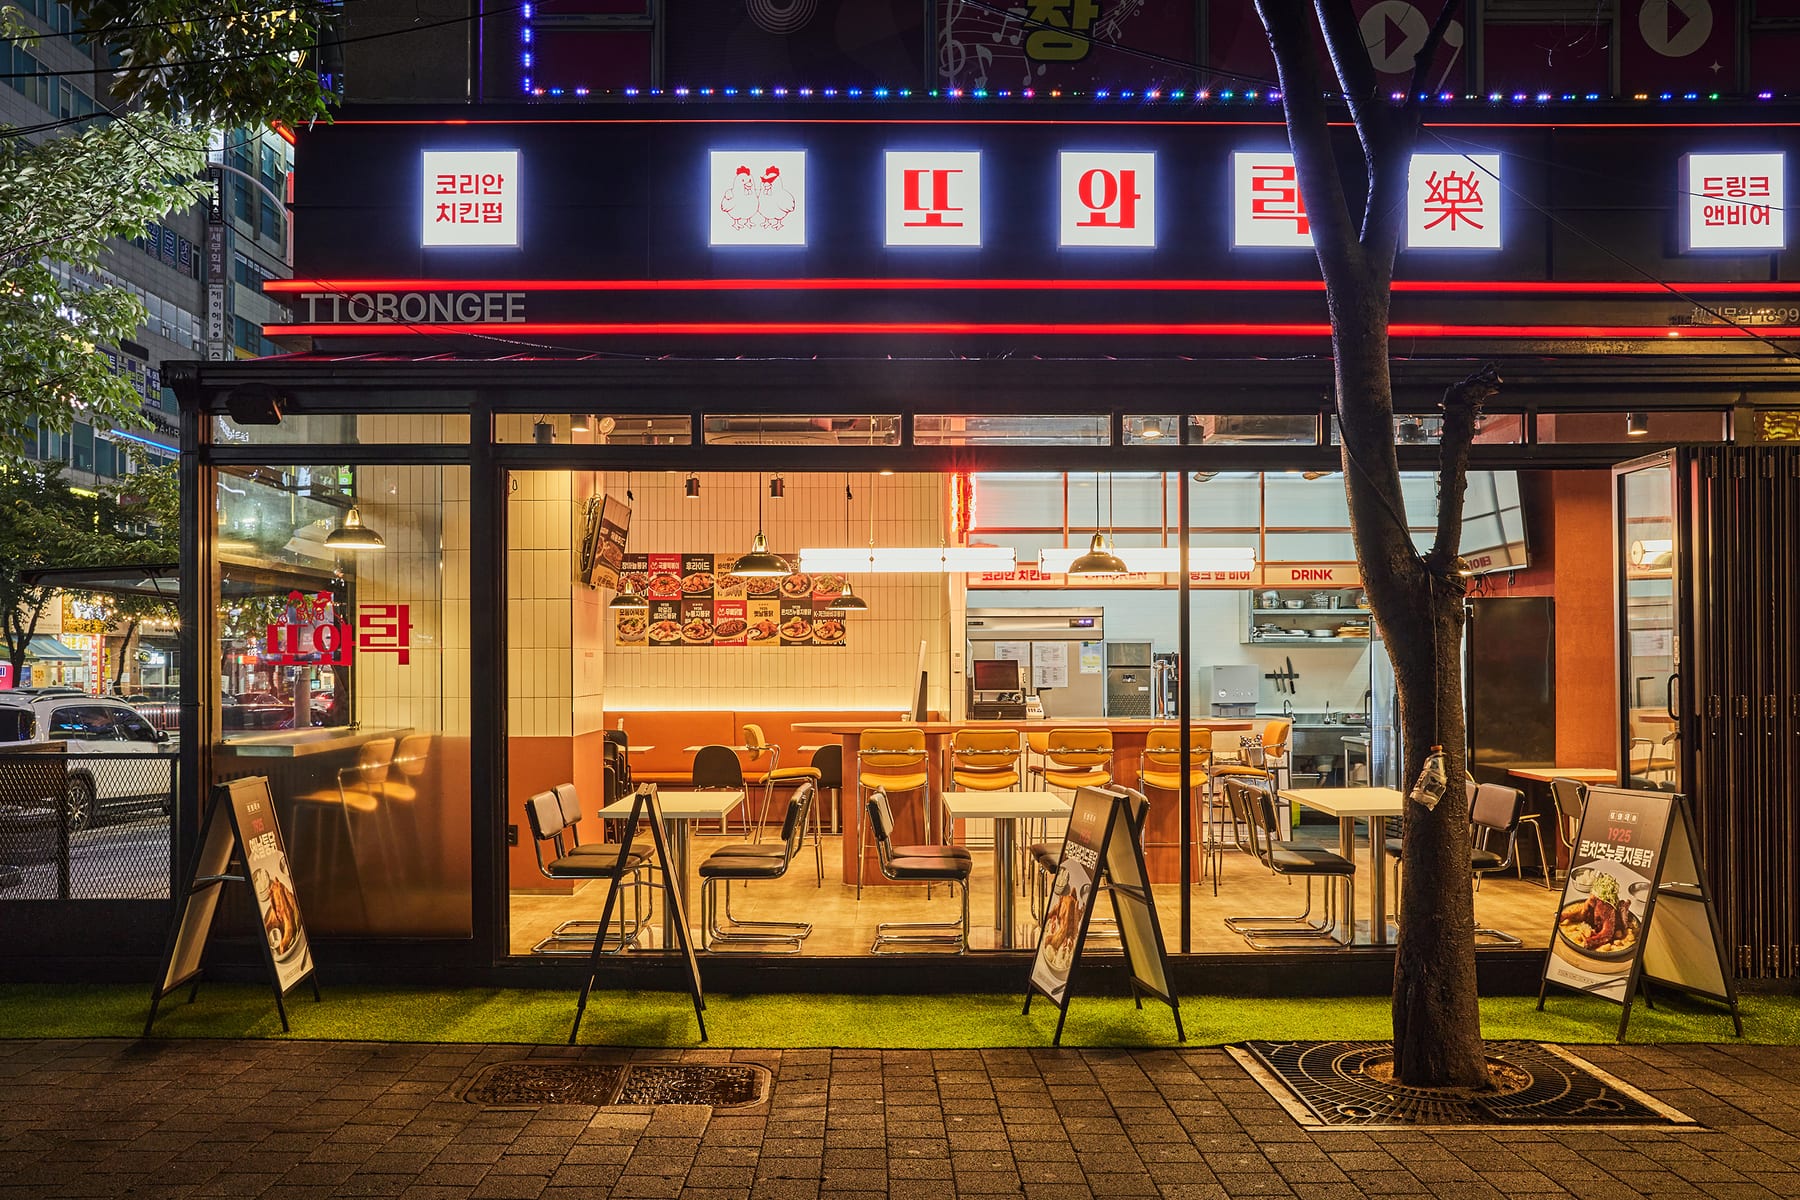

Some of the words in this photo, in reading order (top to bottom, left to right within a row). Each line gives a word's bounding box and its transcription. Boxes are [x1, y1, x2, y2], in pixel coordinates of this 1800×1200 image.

[436, 173, 504, 196] 코리안
[1703, 175, 1770, 198] 드링크
[903, 169, 963, 227] 또
[1076, 168, 1141, 229] 와
[1423, 169, 1485, 231] 樂
[436, 202, 504, 225] 치킨펍
[1703, 204, 1770, 227] 앤비어
[301, 292, 526, 323] TTOBONGEE
[686, 561, 710, 571] 후라이드
[1291, 569, 1333, 581] DRINK
[1607, 827, 1633, 843] 1925
[1578, 839, 1654, 869] 콘치즈누룽지통닭
